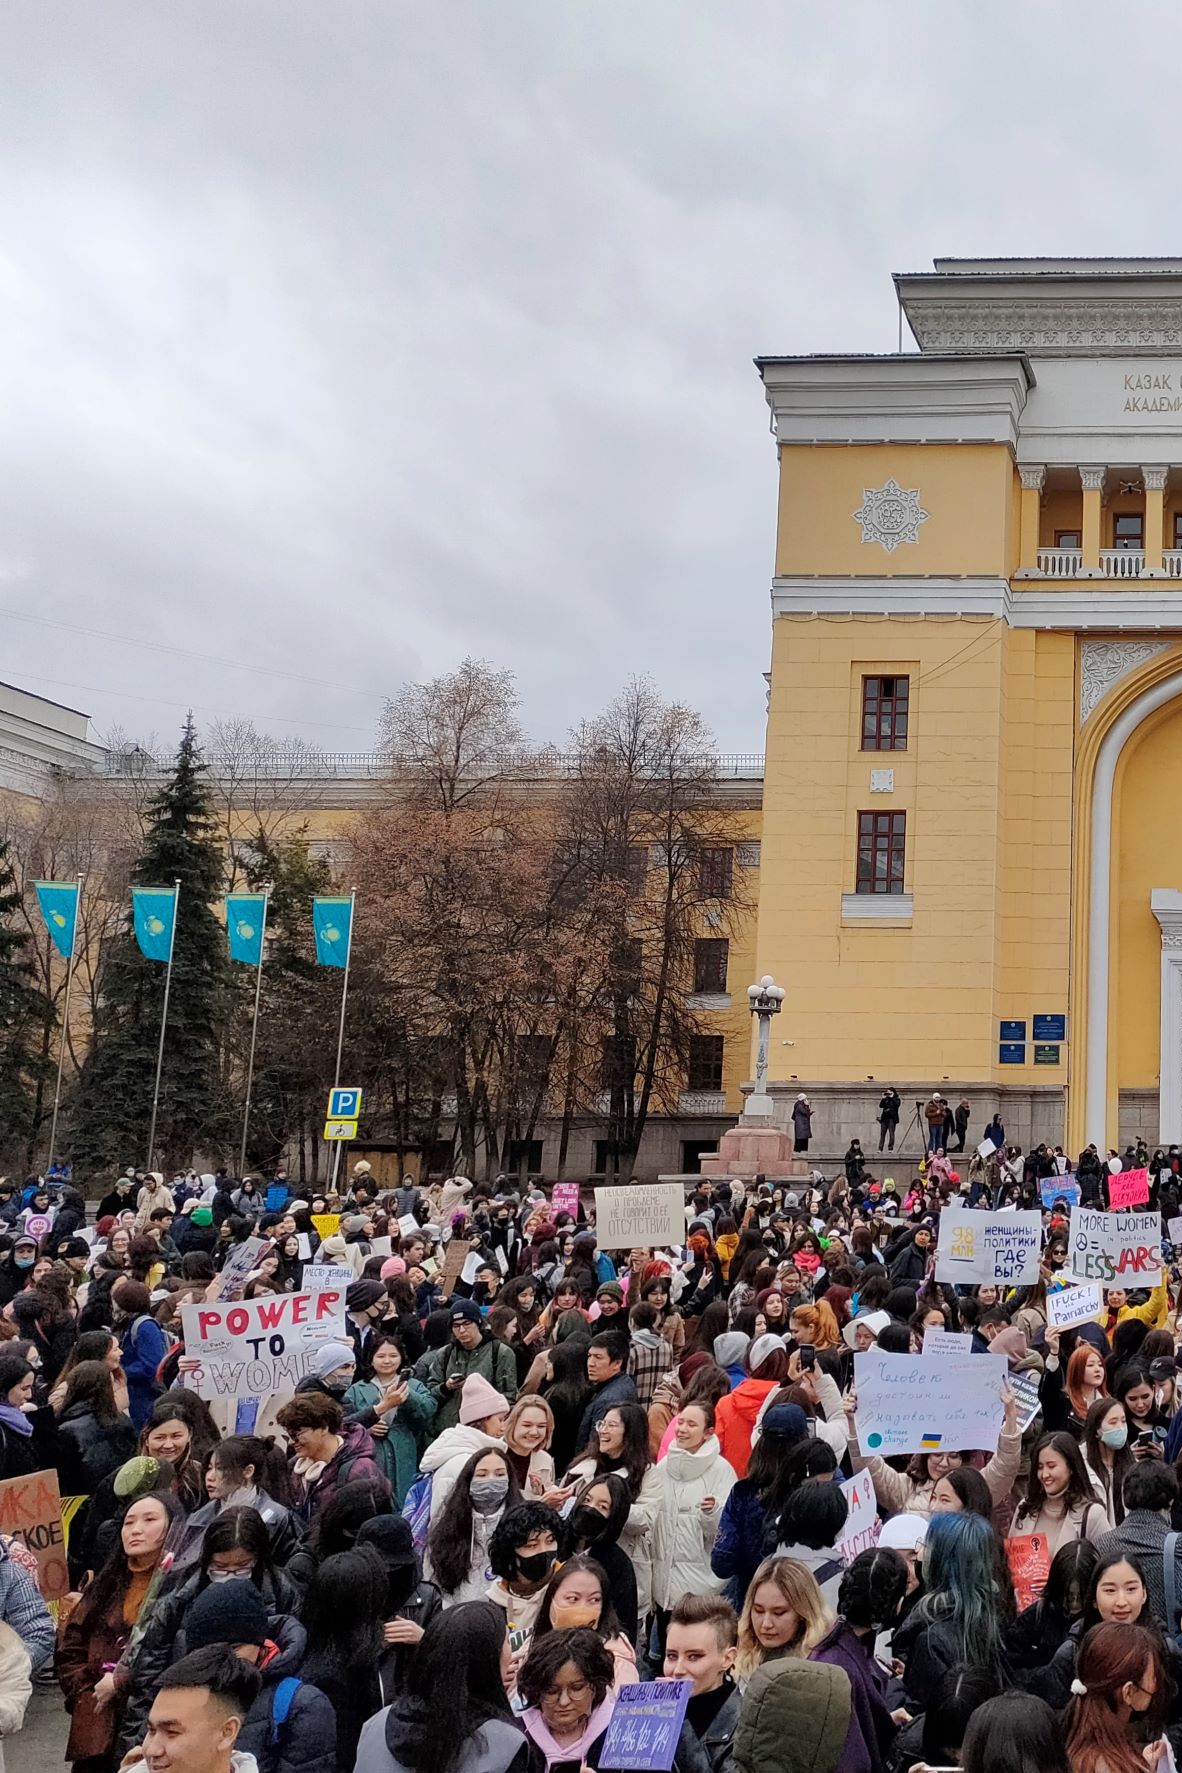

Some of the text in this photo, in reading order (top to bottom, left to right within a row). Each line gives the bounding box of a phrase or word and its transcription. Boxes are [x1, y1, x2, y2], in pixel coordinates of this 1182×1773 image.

[608, 1217, 671, 1237] ОТСУТСТВИИ
[1079, 1214, 1110, 1234] MORE
[1116, 1216, 1158, 1233] WOMEN
[197, 1292, 340, 1340] POWER
[246, 1333, 286, 1361] TO
[210, 1350, 321, 1395] WOME
